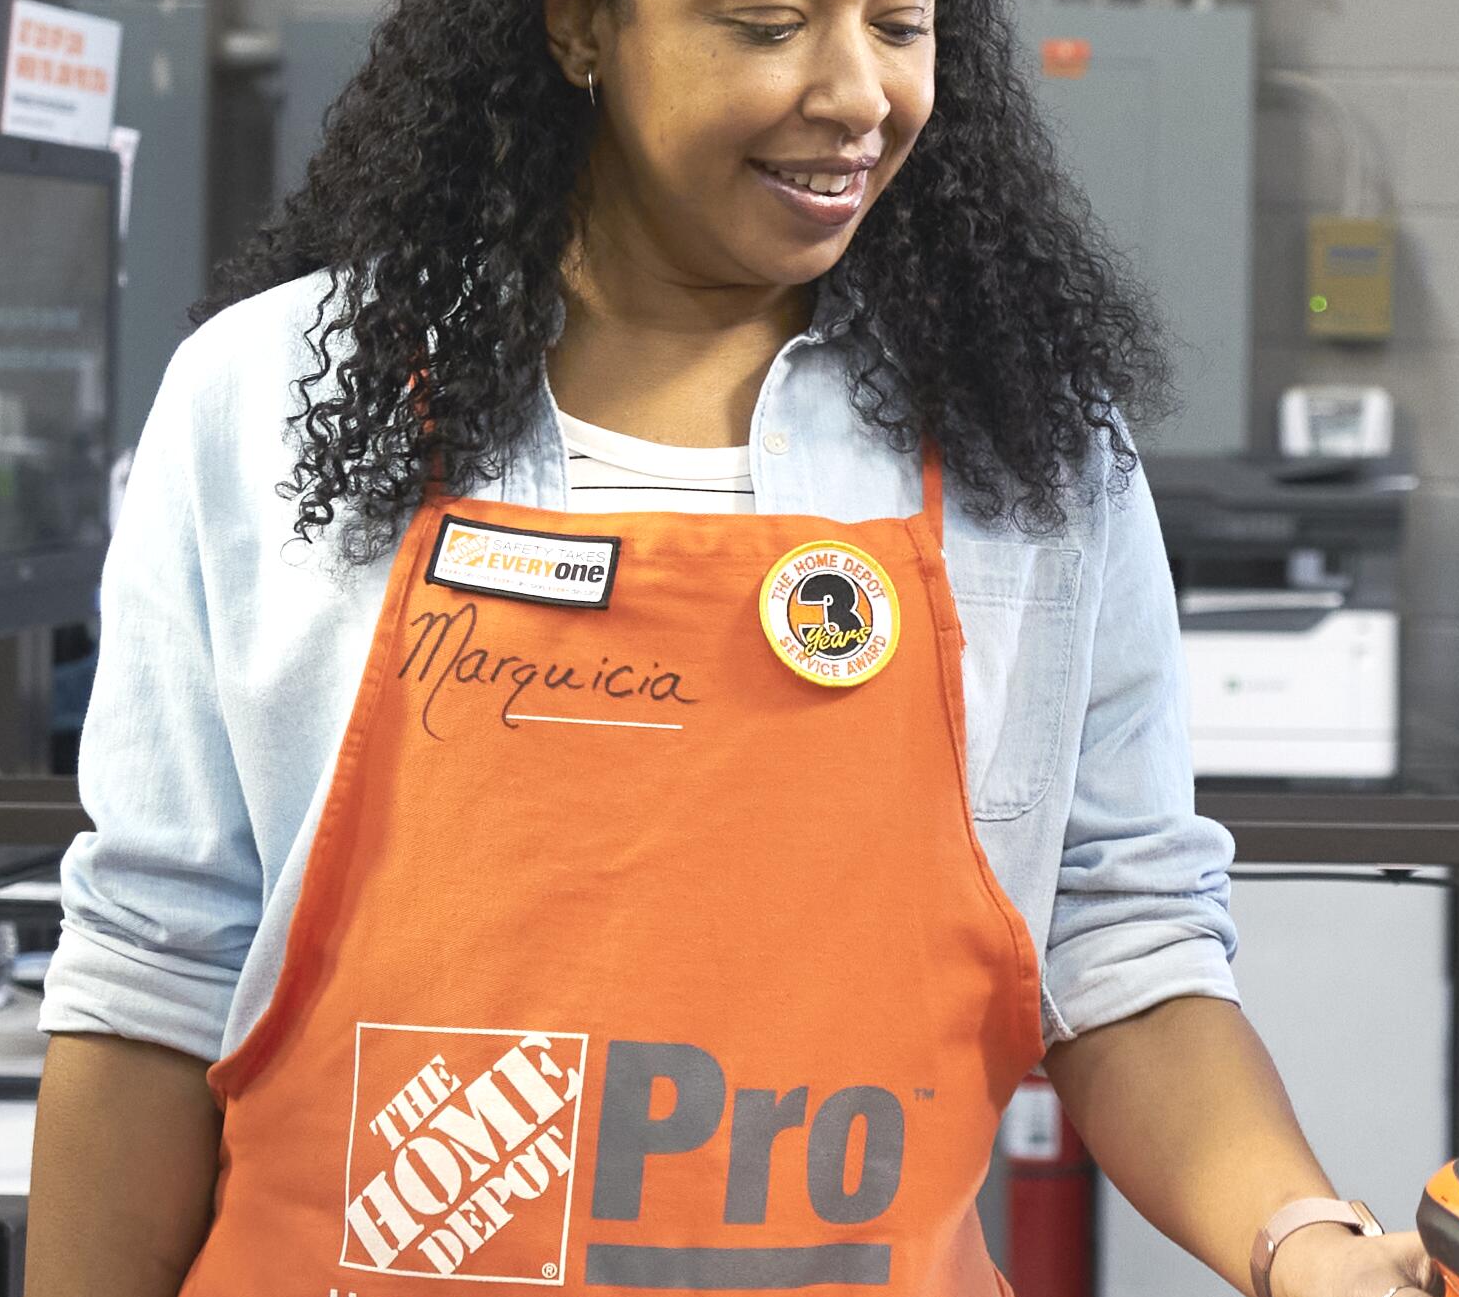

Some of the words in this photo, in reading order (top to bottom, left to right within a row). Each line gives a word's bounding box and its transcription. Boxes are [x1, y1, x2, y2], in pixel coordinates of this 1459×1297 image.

[492, 539, 554, 558] SAFETY
[559, 547, 607, 564] TAKES
[771, 572, 795, 601] THE
[793, 553, 839, 576] HOME
[842, 557, 887, 600] DEPOT
[779, 636, 841, 677] SERVICE
[846, 634, 887, 676] AWARD
[804, 626, 872, 657] Years
[368, 1054, 463, 1151] THE
[589, 1040, 905, 1225] Pro
[346, 1033, 582, 1271] HOME
[417, 1125, 573, 1276] DEPOT
